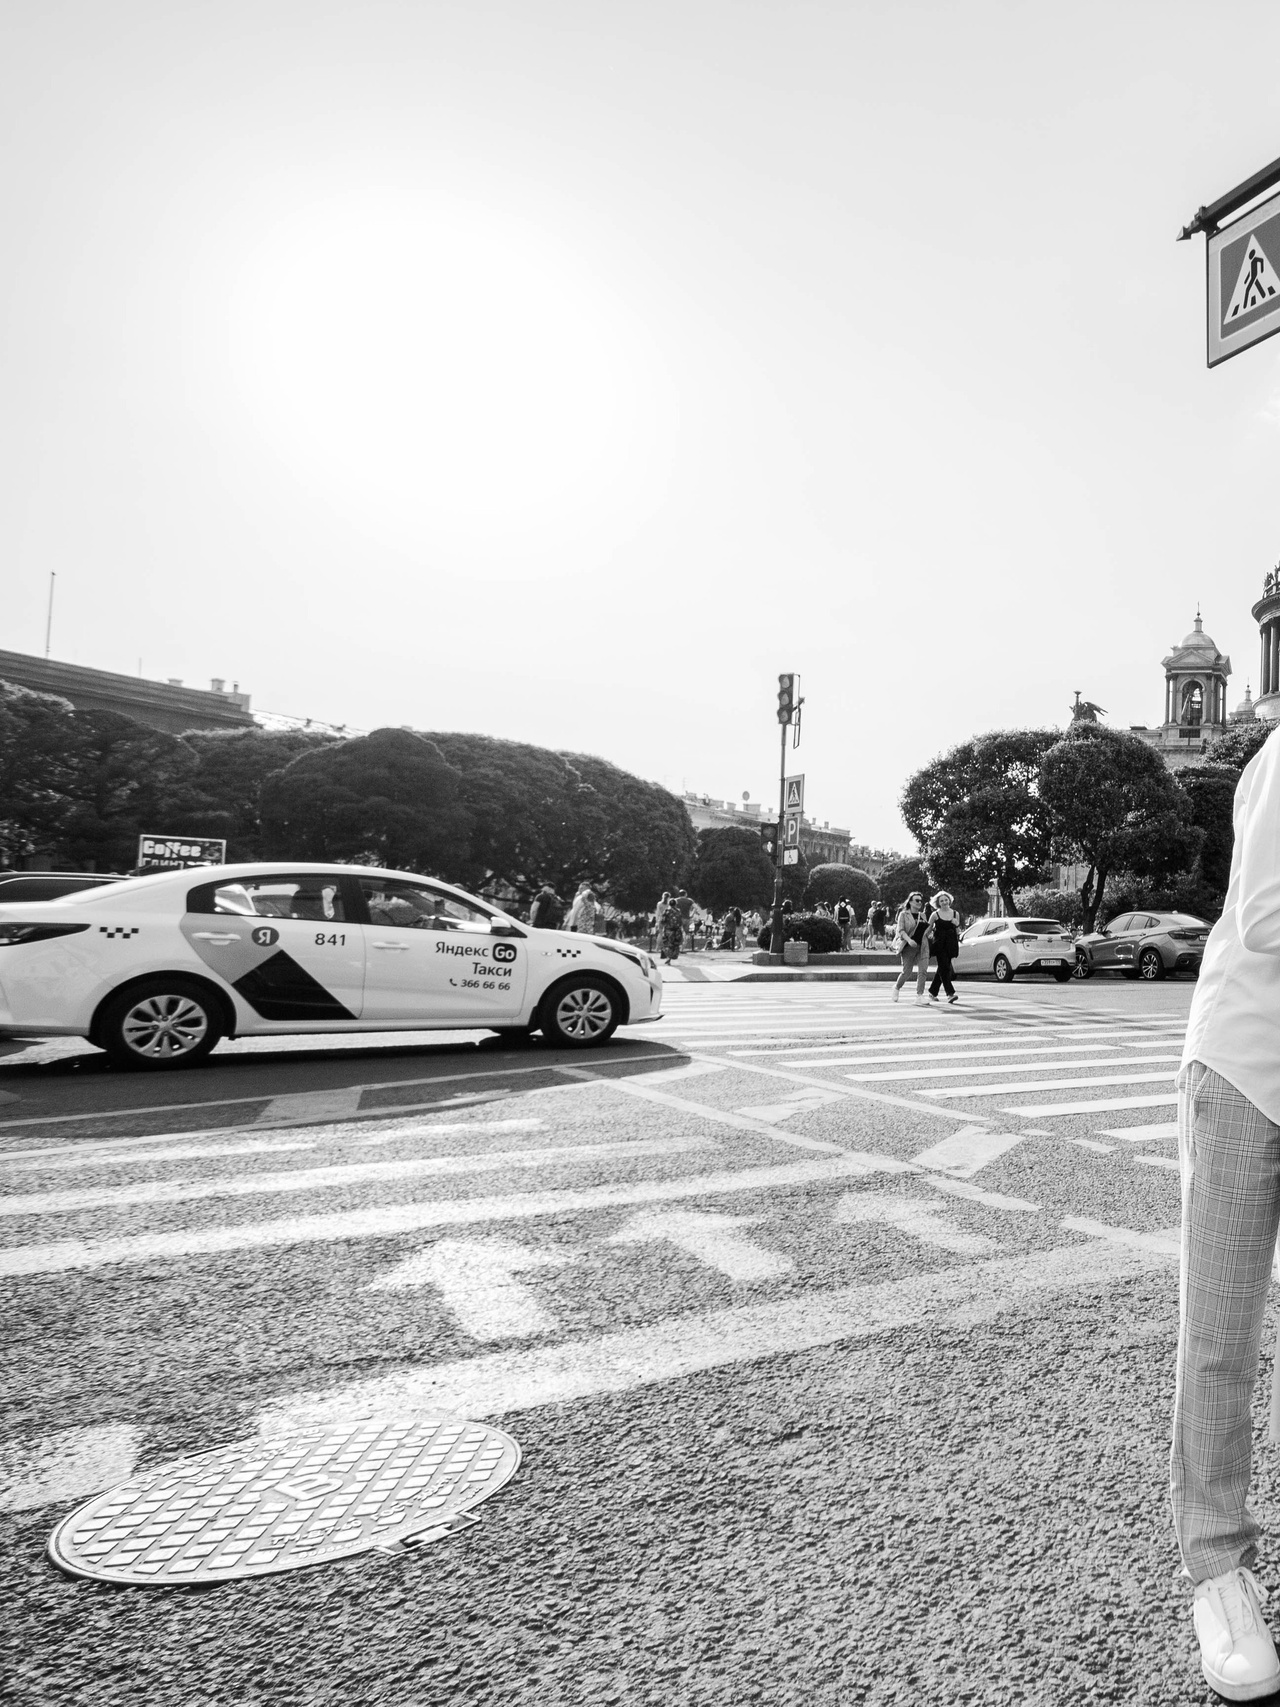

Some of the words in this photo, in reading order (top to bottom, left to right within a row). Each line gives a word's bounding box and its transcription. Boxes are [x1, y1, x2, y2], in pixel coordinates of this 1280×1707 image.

[788, 820, 796, 842] P
[143, 840, 202, 858] Coffee
[257, 928, 272, 944] Я
[314, 932, 347, 947] 841
[435, 941, 489, 957] Яндекс
[494, 945, 515, 960] Go
[472, 961, 513, 977] Такси
[460, 979, 480, 988] 366
[482, 980, 495, 990] 66
[498, 982, 511, 991] 66
